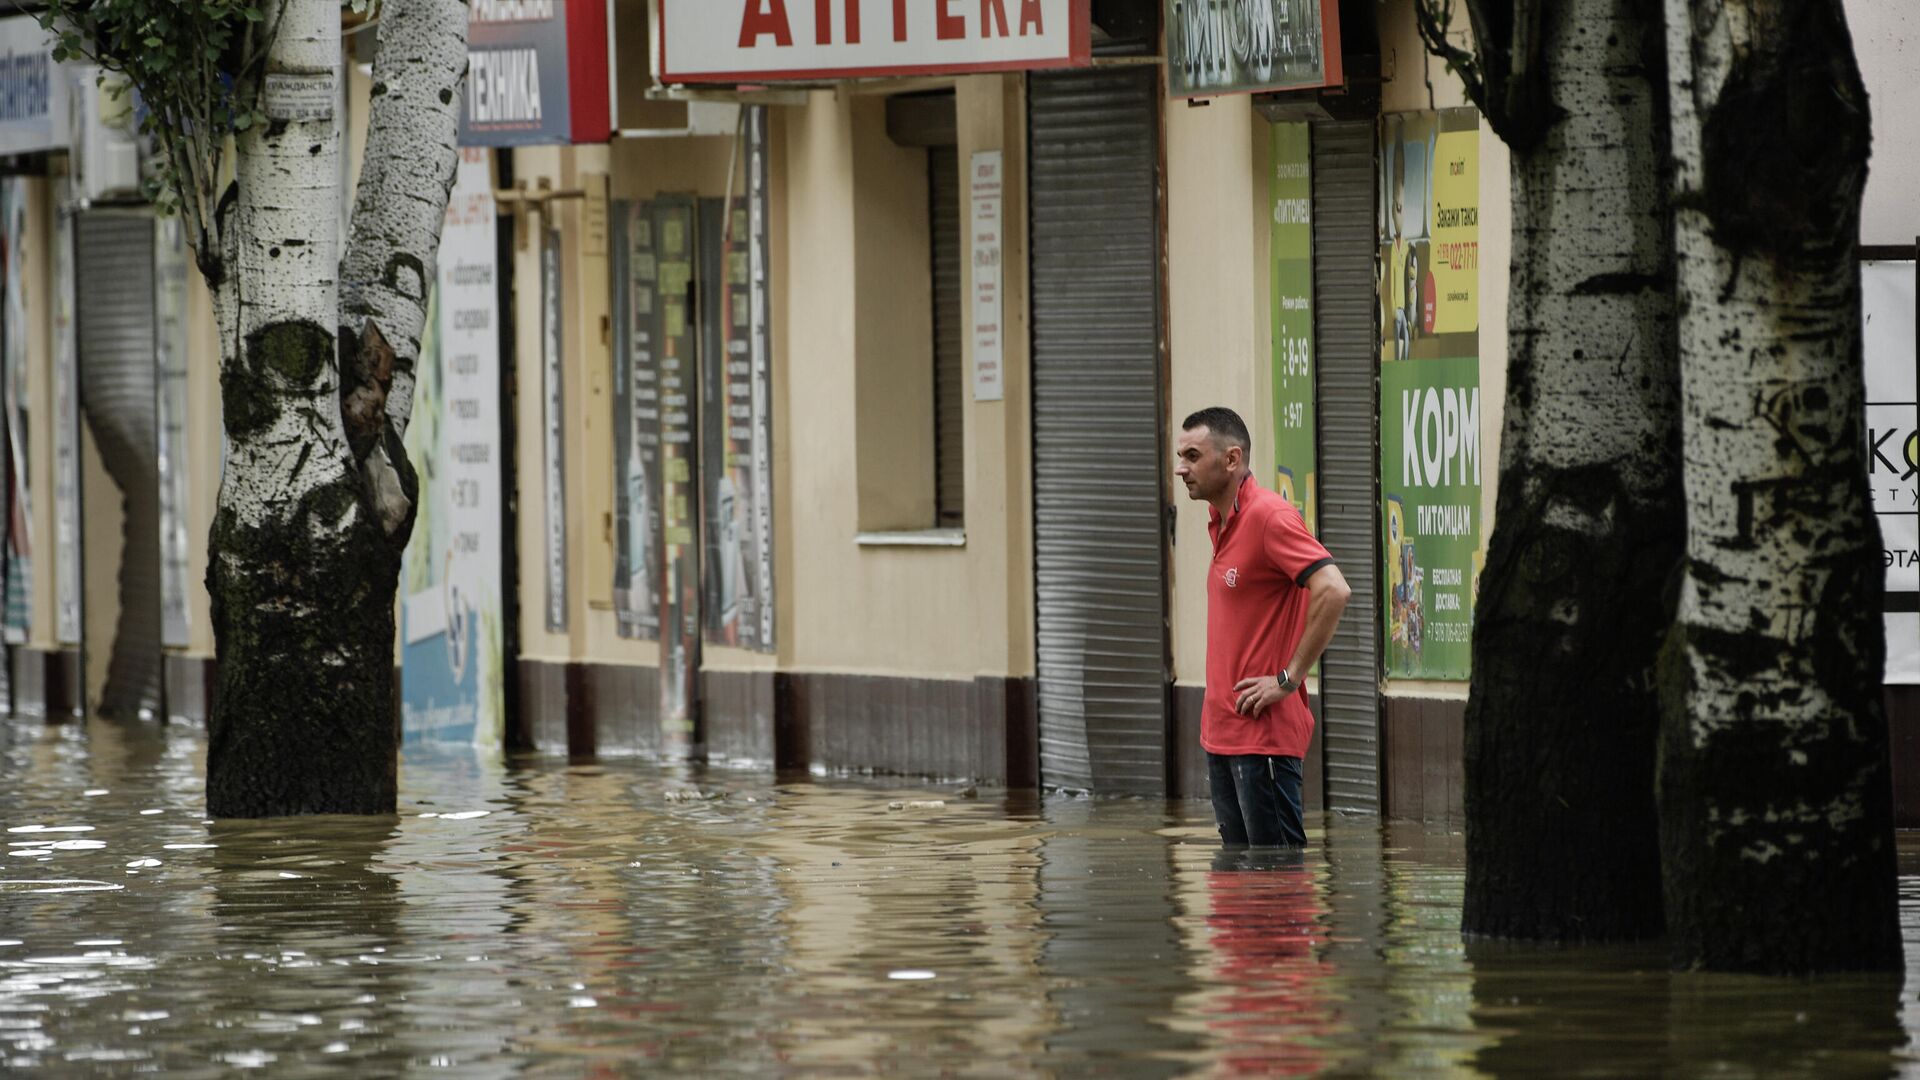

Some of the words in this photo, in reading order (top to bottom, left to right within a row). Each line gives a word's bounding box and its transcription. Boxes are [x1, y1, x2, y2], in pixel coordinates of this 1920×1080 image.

[737, 0, 1044, 49] АПТЕКА
[468, 49, 543, 122] ТЕХНИКА
[1437, 202, 1461, 228] Закажи
[1461, 206, 1478, 228] такси
[1288, 337, 1308, 377] 8-19
[1289, 402, 1303, 429] 9-17
[1402, 386, 1481, 488] КОРМ
[1417, 504, 1471, 541] ПИТОМЦАМ
[1432, 568, 1462, 586] БЕСПЛАТНАЯ
